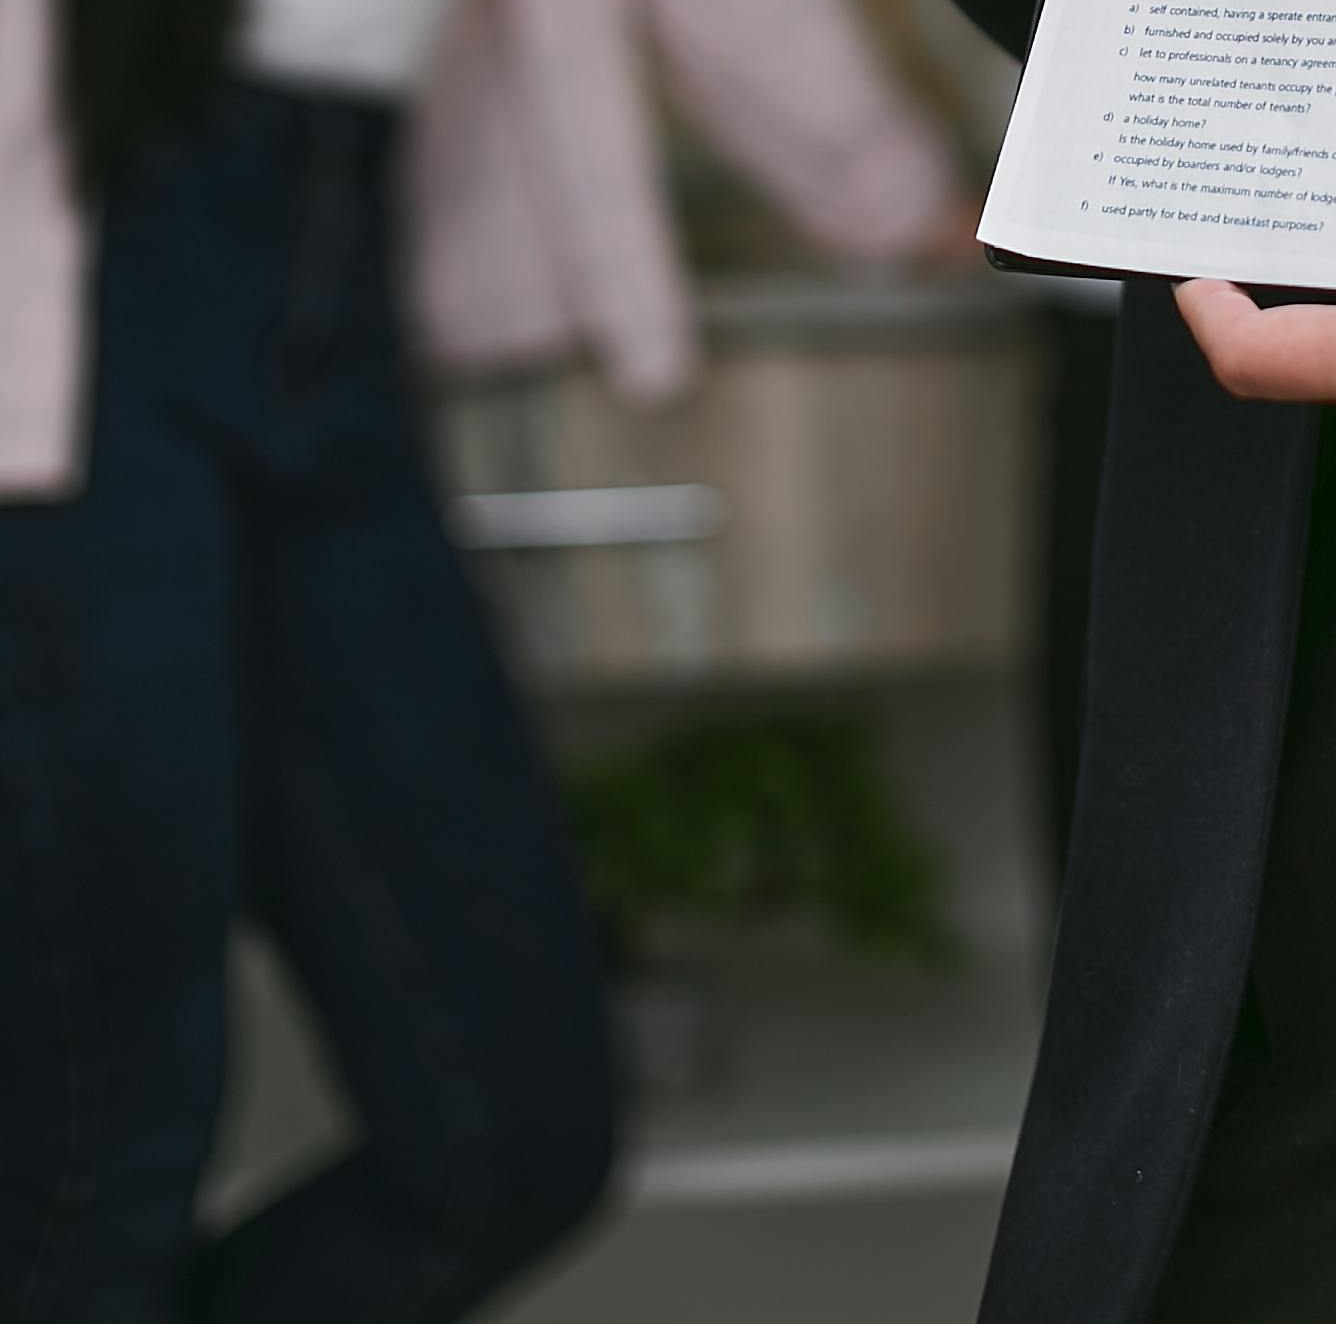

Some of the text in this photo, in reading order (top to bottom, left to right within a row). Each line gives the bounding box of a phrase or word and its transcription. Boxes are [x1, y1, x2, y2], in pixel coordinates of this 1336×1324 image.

[1128, 91, 1312, 114] what is the total number of tenants?
[1103, 111, 1207, 129] d) a holiday home?
[1080, 199, 1325, 232] f) used partly for bed and breakfast purposes?
